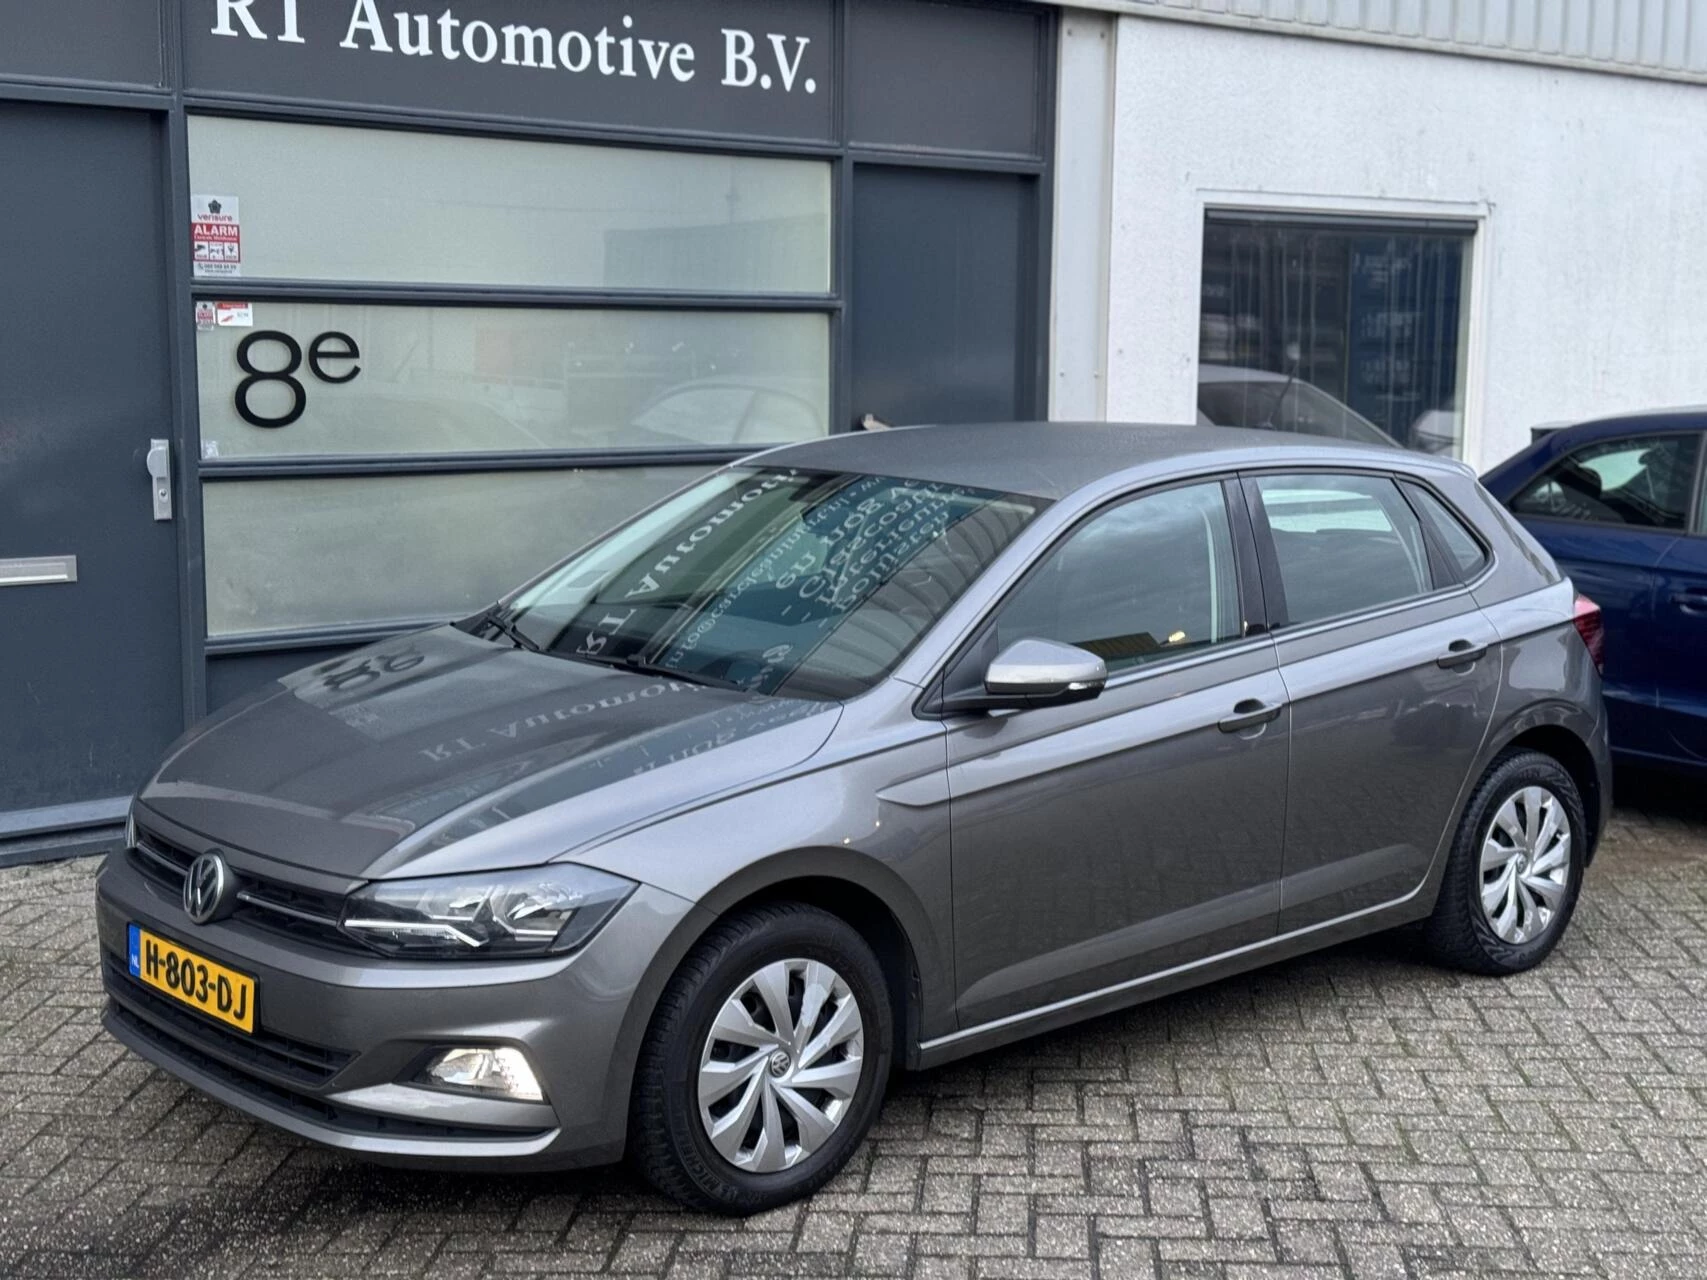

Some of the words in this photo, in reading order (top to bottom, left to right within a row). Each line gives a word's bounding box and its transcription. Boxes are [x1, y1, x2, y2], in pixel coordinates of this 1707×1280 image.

[340, 0, 695, 82] Automotive
[721, 28, 816, 93] B.V.
[194, 224, 239, 236] ALARM
[234, 330, 361, 428] 8e
[131, 955, 139, 968] NL
[145, 939, 248, 1021] H-803-DJ
